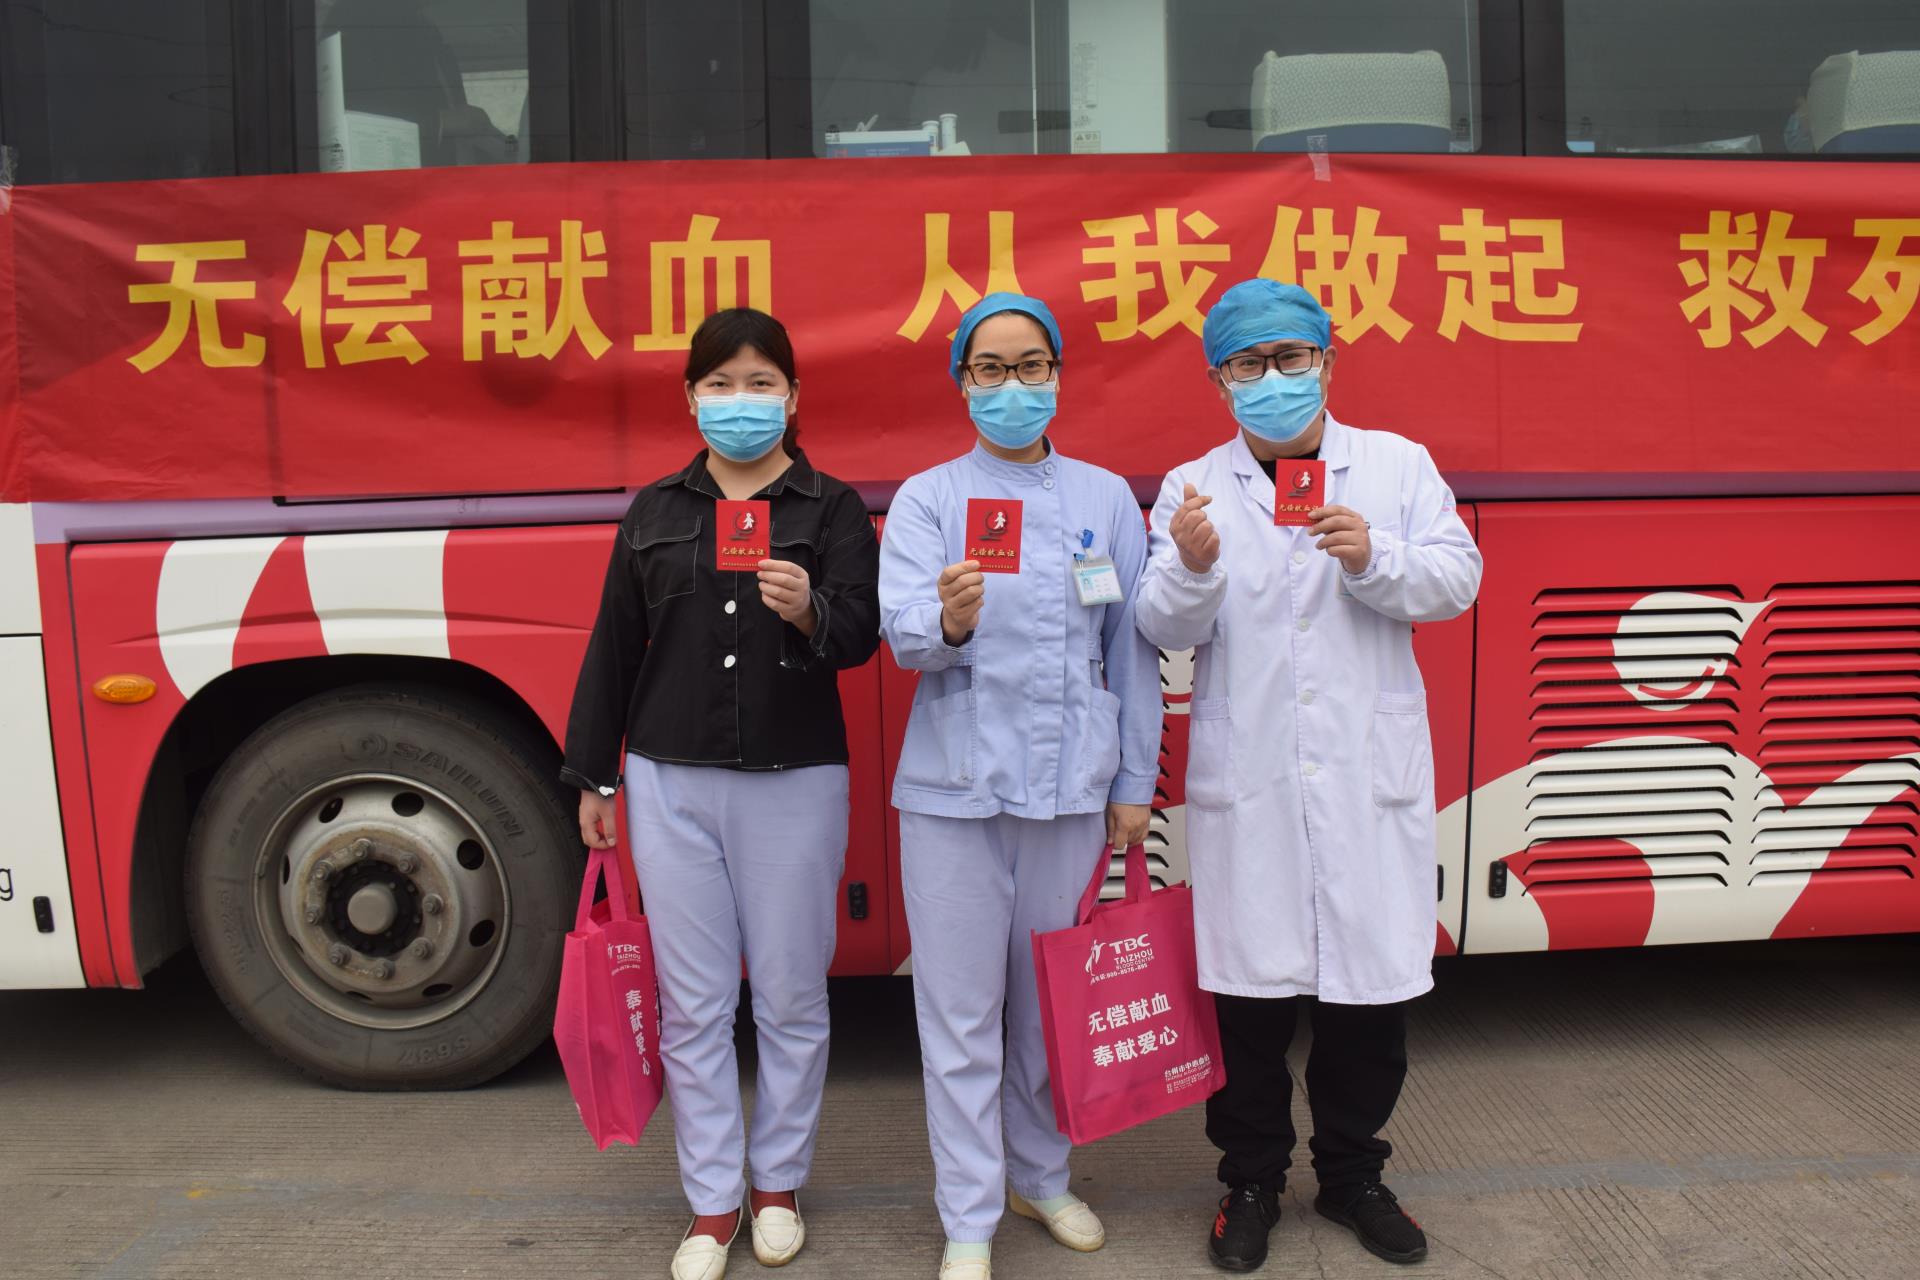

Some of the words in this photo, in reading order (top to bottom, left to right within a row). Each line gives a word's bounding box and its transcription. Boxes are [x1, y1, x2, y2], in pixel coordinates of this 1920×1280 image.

[126, 214, 773, 374] 无偿献血
[896, 204, 1584, 346] 从我做起
[969, 547, 1015, 558] 无偿献血证
[615, 944, 641, 954] TBC
[1109, 933, 1151, 955] TBC
[1114, 948, 1153, 965] TAIZHOU
[1088, 992, 1172, 1036] 无偿献血
[1092, 1024, 1179, 1068] 奉献爱心
